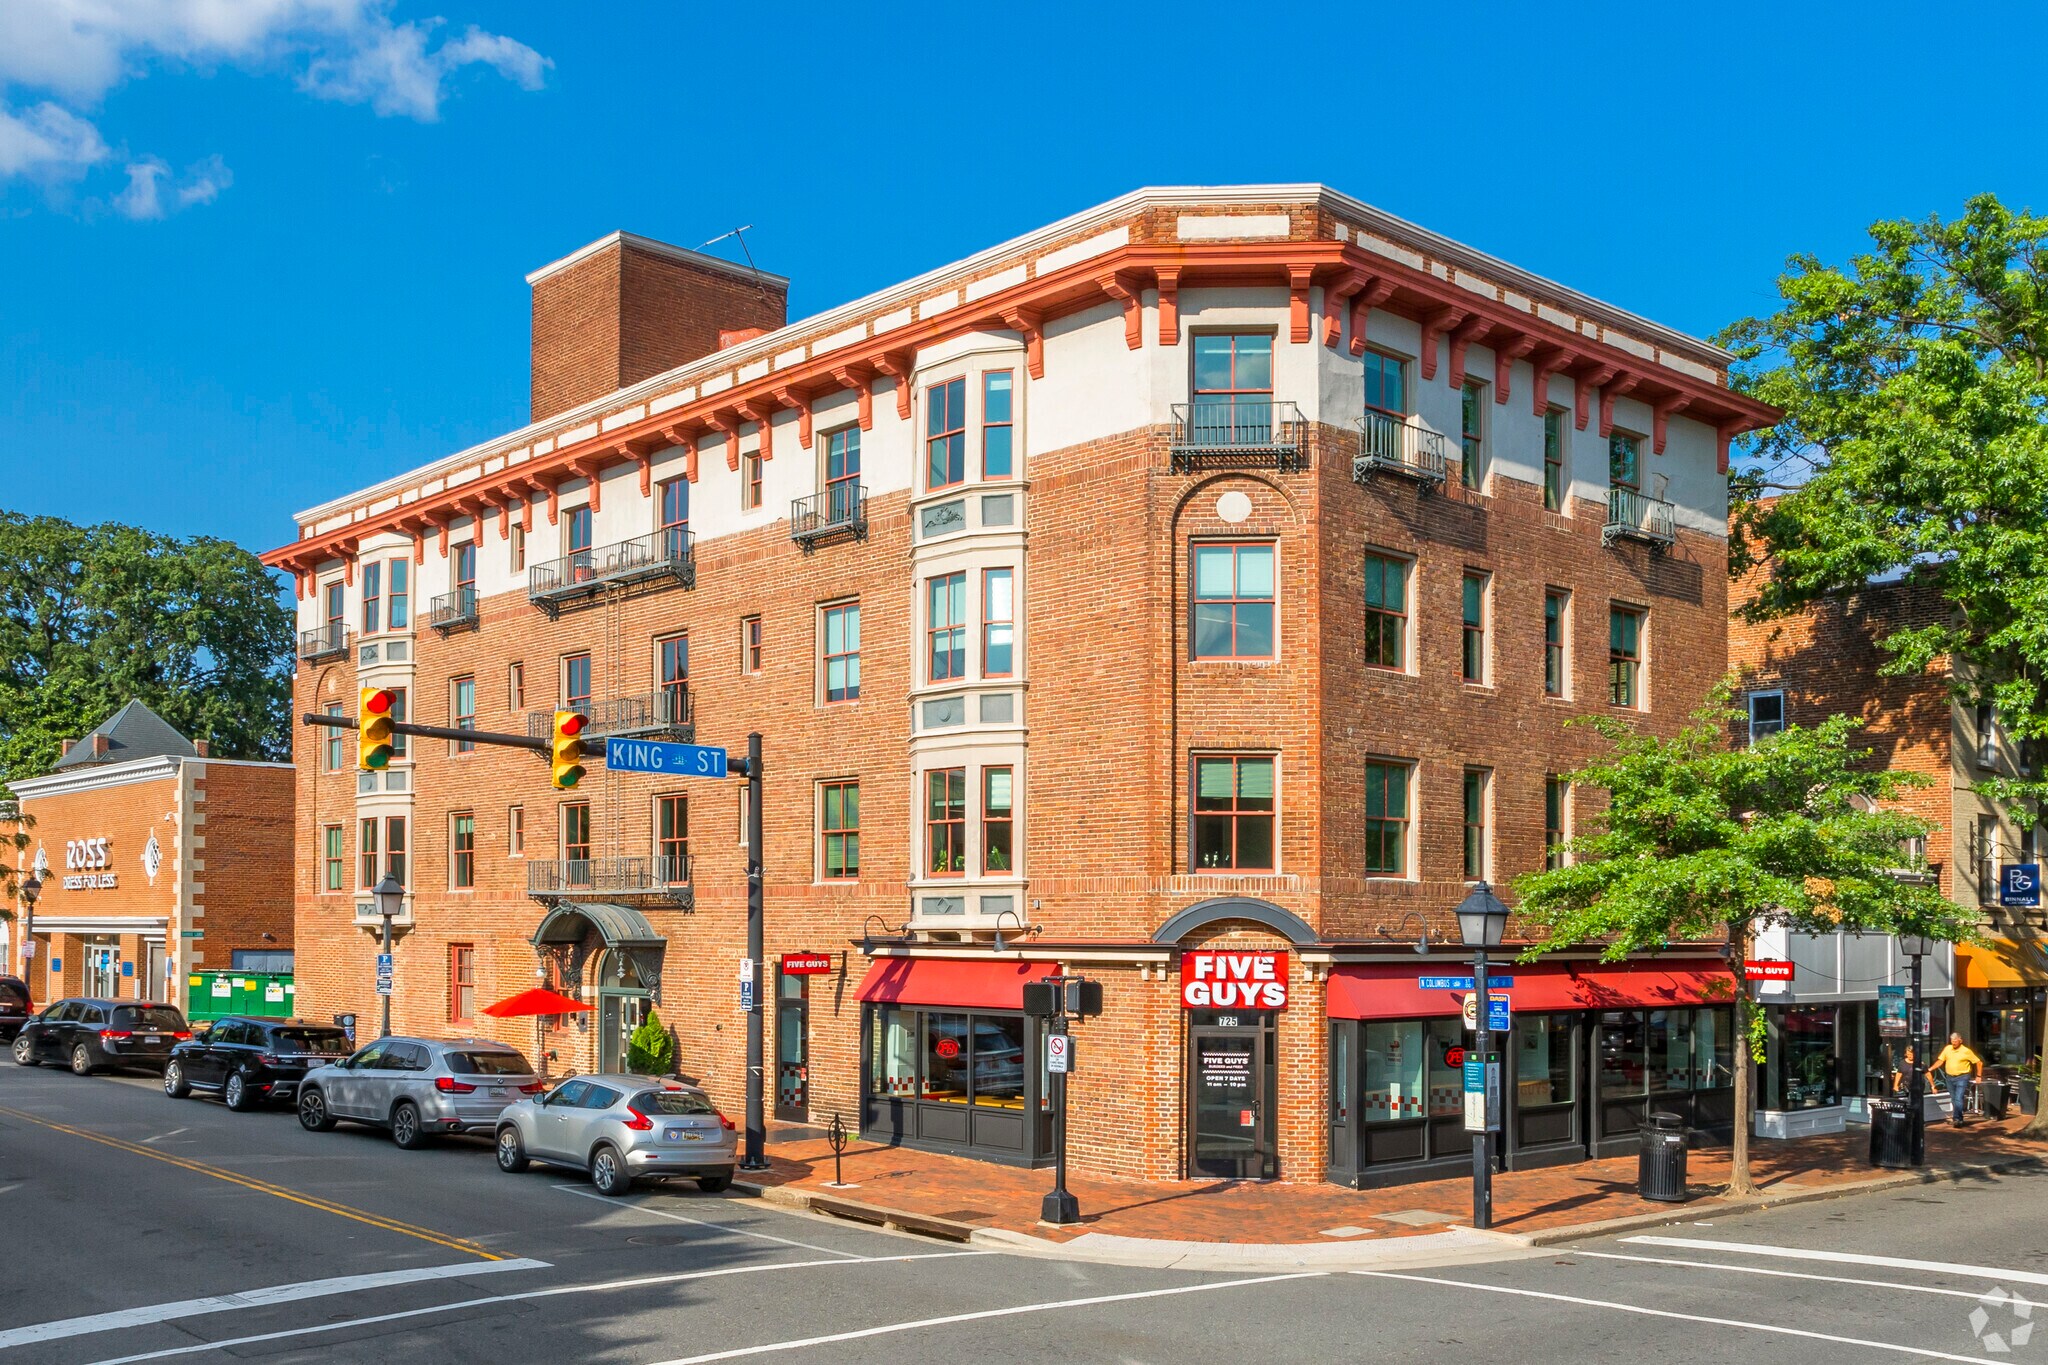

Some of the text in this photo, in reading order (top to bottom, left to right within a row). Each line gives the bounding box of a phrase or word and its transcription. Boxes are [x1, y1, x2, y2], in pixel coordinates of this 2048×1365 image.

[613, 743, 721, 773] KING ST
[66, 837, 107, 869] ROSS
[63, 873, 116, 890] DRESS FOR LESS
[382, 955, 389, 963] P
[786, 960, 829, 969] FIVE GUYS
[1195, 956, 1275, 979] FIVE
[1764, 967, 1790, 975] GUYS
[744, 982, 749, 992] P
[1420, 979, 1425, 987] N
[1426, 979, 1450, 988] COLUMBUS
[1184, 981, 1286, 1007] GUYS
[1220, 1017, 1237, 1026] 725
[1203, 1057, 1249, 1065] FIVE GUYS
